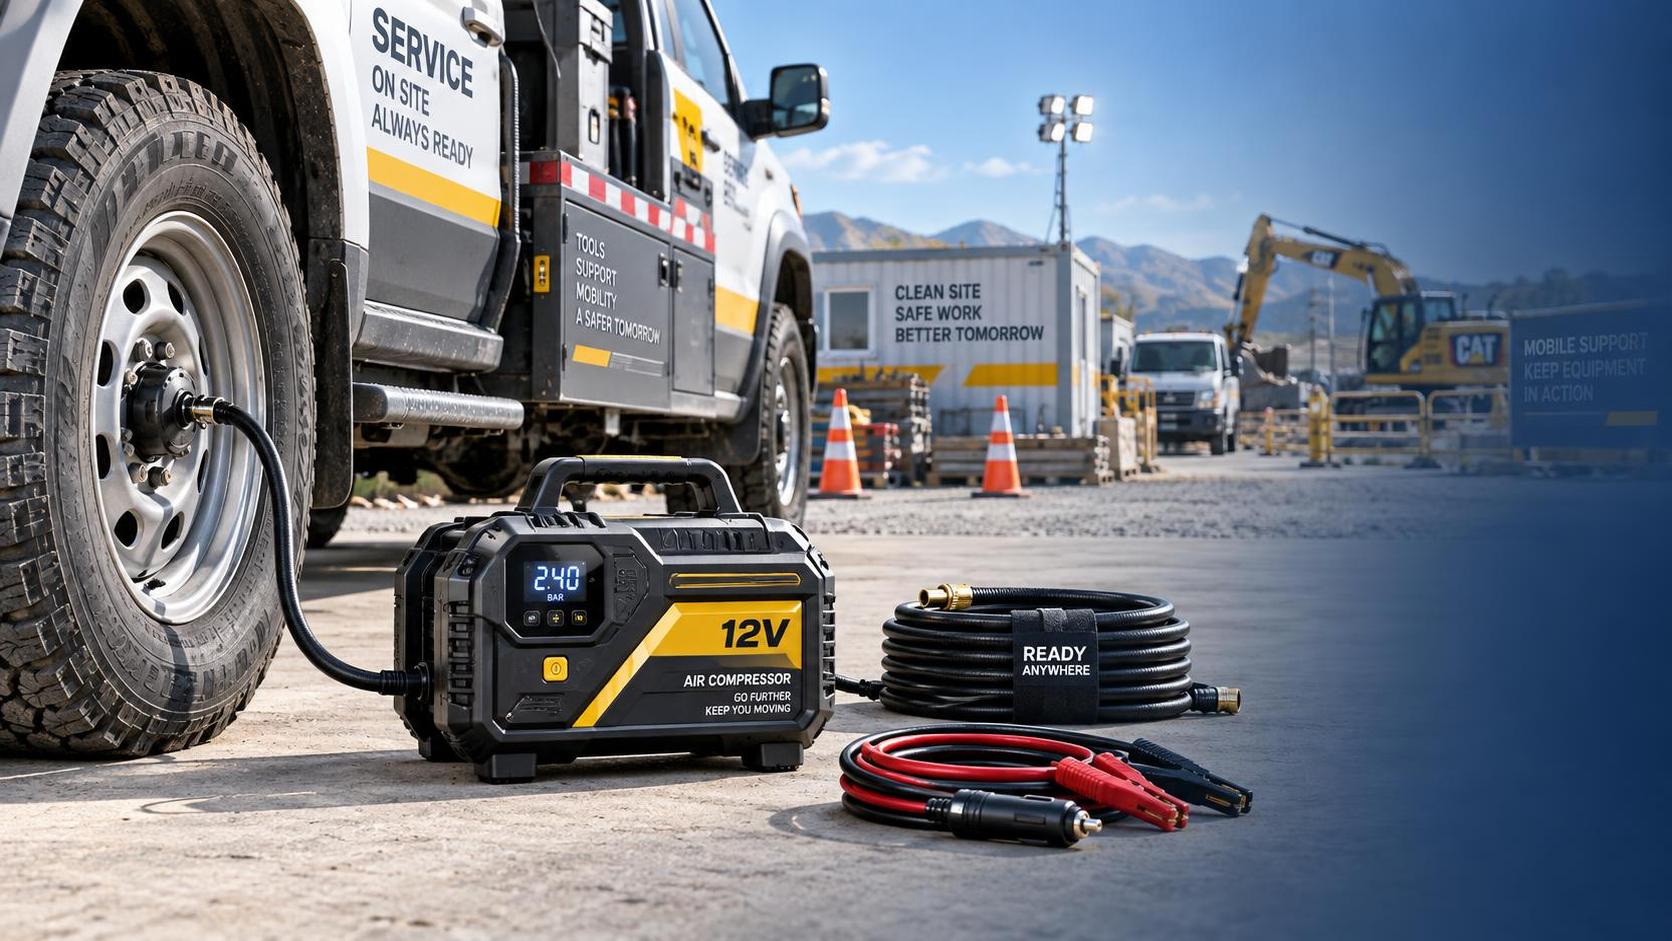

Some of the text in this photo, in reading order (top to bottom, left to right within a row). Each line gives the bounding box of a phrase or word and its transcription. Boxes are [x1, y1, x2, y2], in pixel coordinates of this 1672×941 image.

[372, 7, 473, 98] SERVICE
[372, 65, 430, 117] ON SITE
[372, 103, 474, 169] ALWAYS READY
[576, 232, 605, 259] TOOLS
[576, 258, 617, 287] SUPPORT
[576, 282, 617, 310] MOBILITY
[895, 283, 981, 301] CLEAN SITE
[895, 305, 982, 322] SAFE WORK
[576, 307, 660, 344] A SAFER TOMORROW
[895, 325, 1044, 343] BETTER TOMORROW
[1457, 335, 1497, 364] CAT
[1524, 332, 1648, 356] MOBILE SUPPORT
[1524, 358, 1647, 380] KEEP EQUIPMENT
[1524, 384, 1594, 402] IN ACTION
[534, 566, 579, 591] 2.40
[547, 593, 564, 602] BAR
[721, 619, 791, 648] 12V
[1023, 646, 1087, 661] READY
[683, 673, 791, 687] AIR COMPRESSOR
[1022, 665, 1090, 676] ANYWHERE
[734, 691, 791, 702] GO FURTHER
[705, 703, 791, 716] KEEP YOU MOVING
